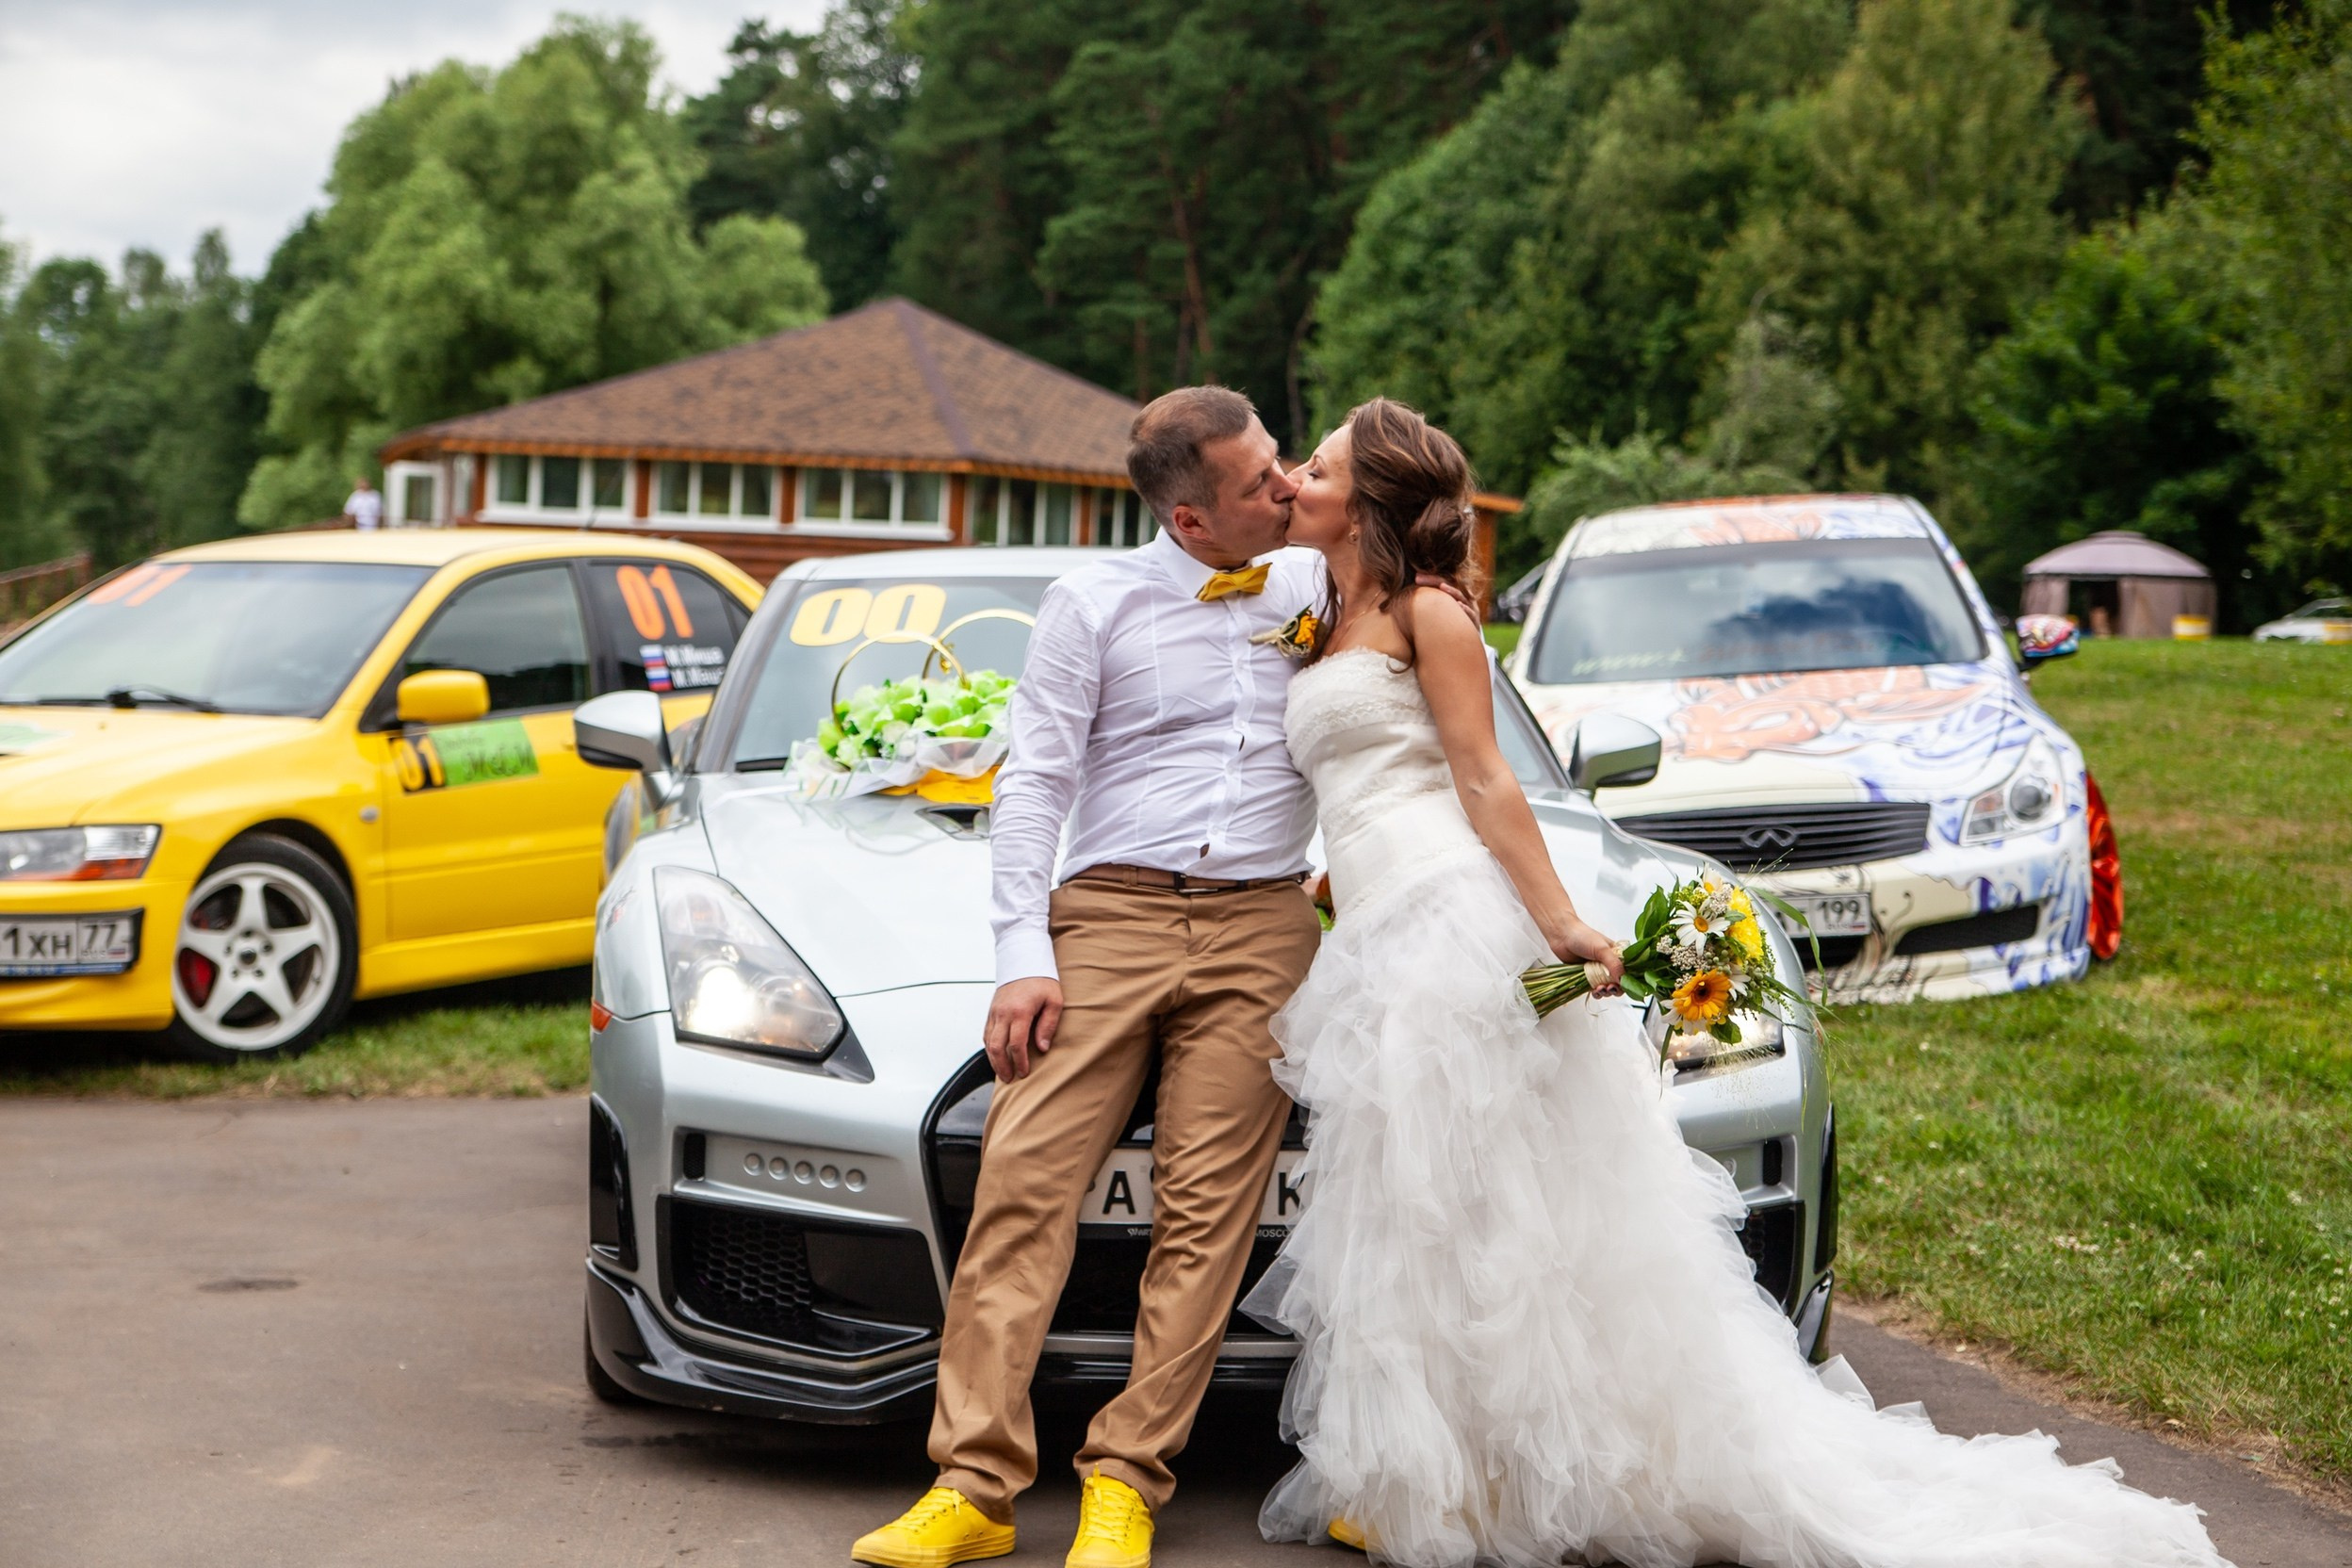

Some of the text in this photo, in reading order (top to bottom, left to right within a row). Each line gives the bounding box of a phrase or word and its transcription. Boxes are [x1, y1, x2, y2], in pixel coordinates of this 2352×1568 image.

[615, 564, 694, 640] 01
[790, 583, 947, 646] 00
[391, 735, 445, 792] 01
[83, 923, 118, 951] 77
[1818, 899, 1860, 925] 199
